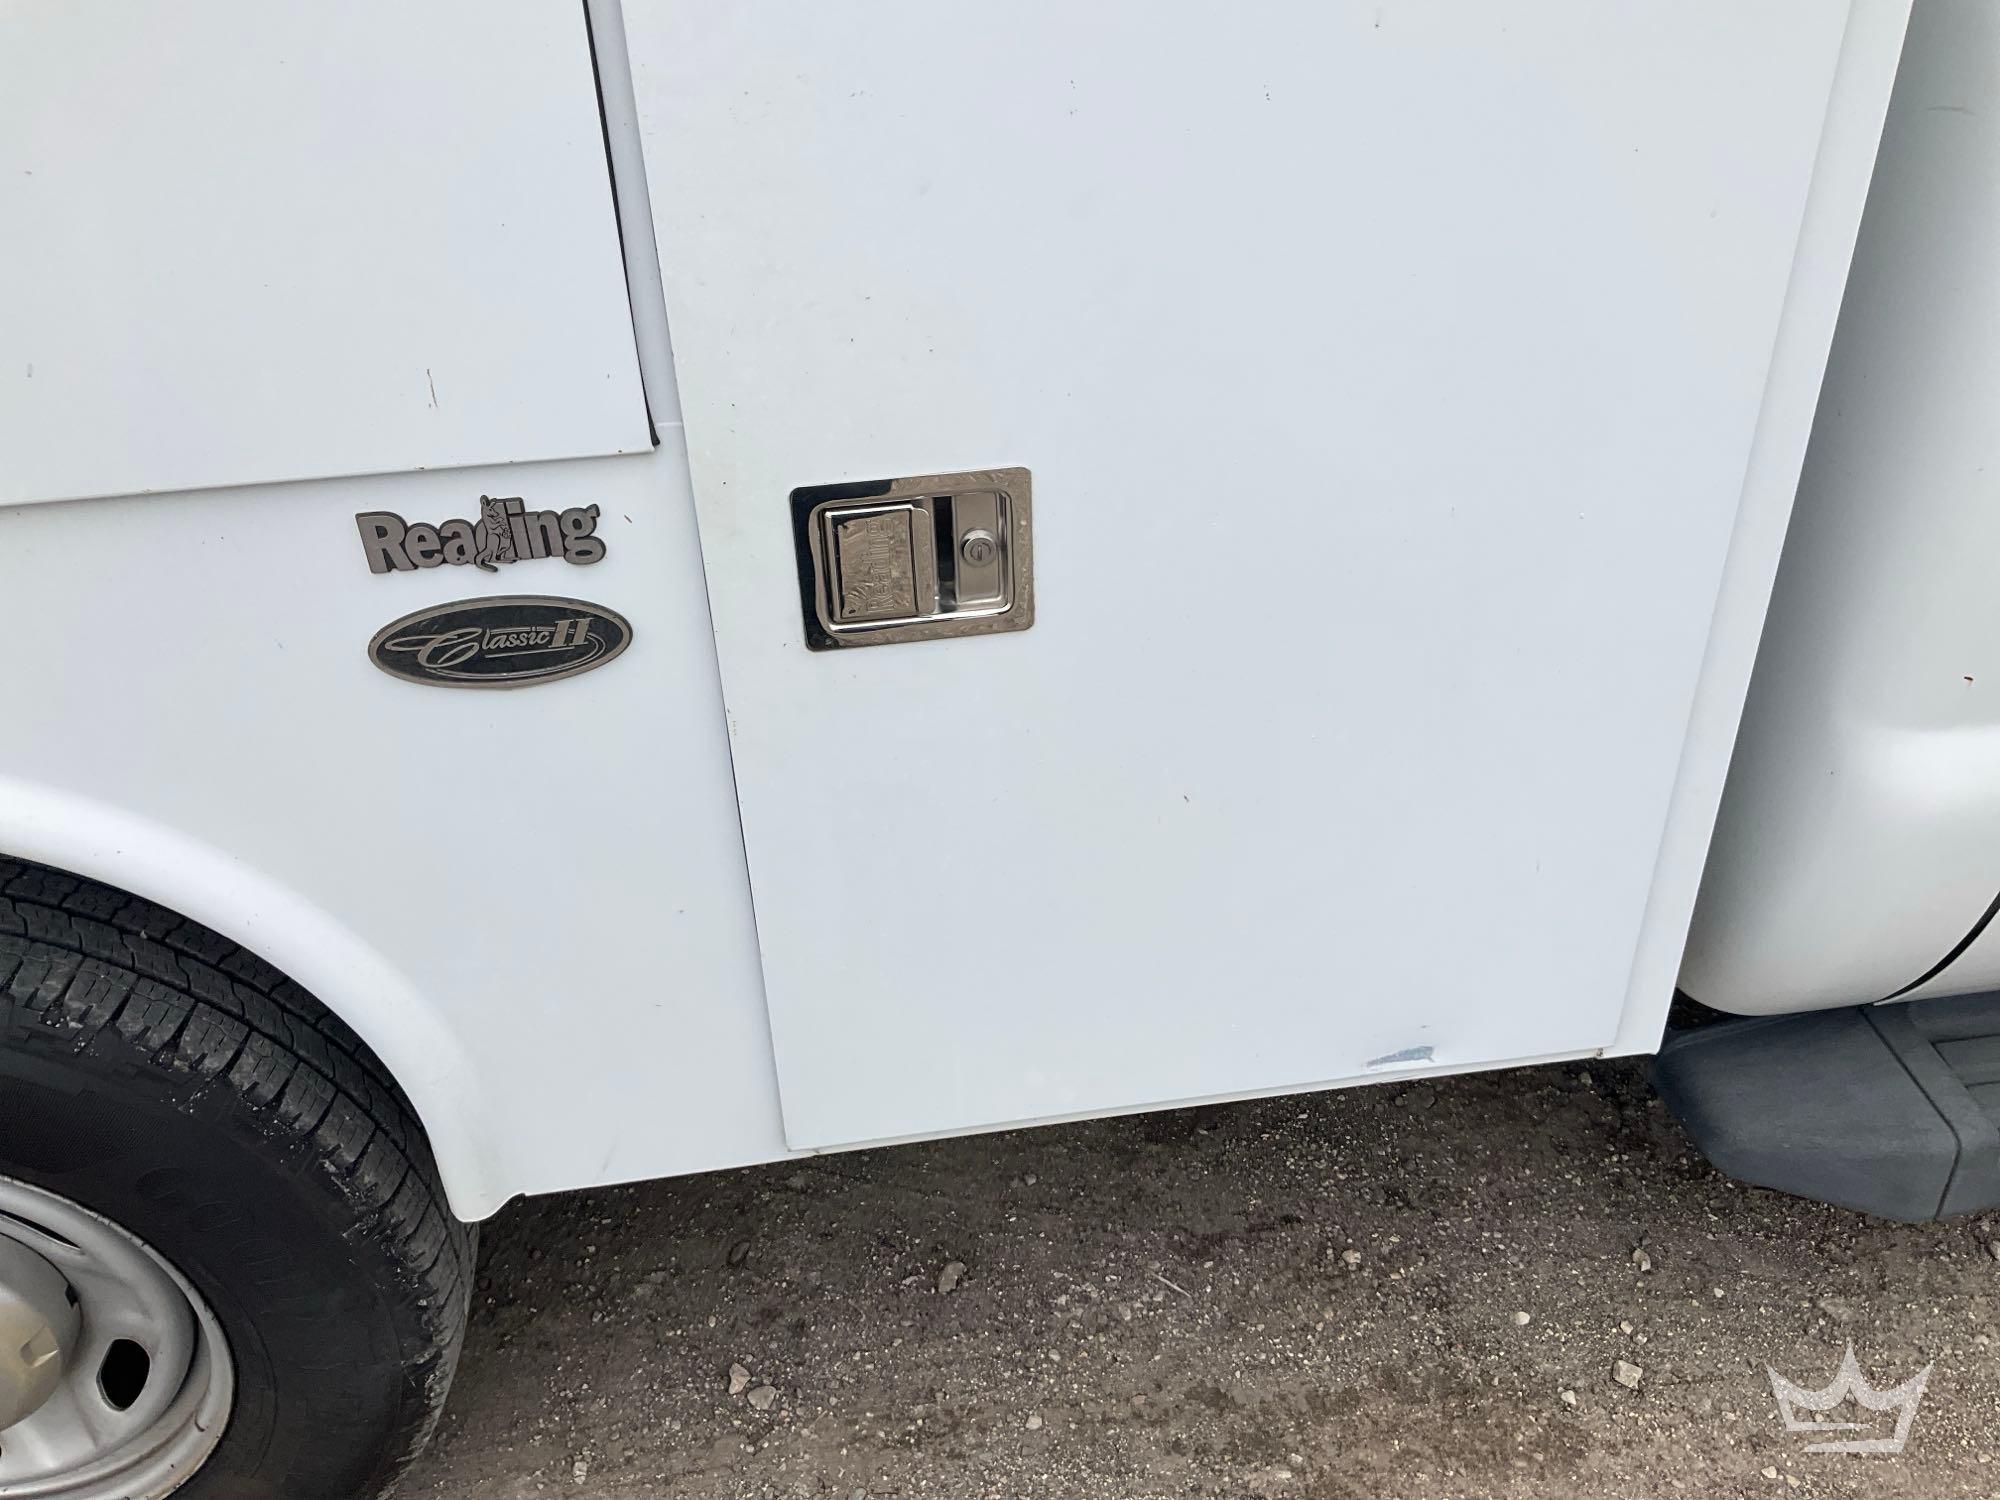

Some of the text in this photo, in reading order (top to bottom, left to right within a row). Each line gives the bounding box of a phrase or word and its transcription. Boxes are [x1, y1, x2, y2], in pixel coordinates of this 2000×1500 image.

[355, 495, 607, 574] Reading
[866, 517, 896, 613] Reading
[385, 616, 594, 668] Classic II
